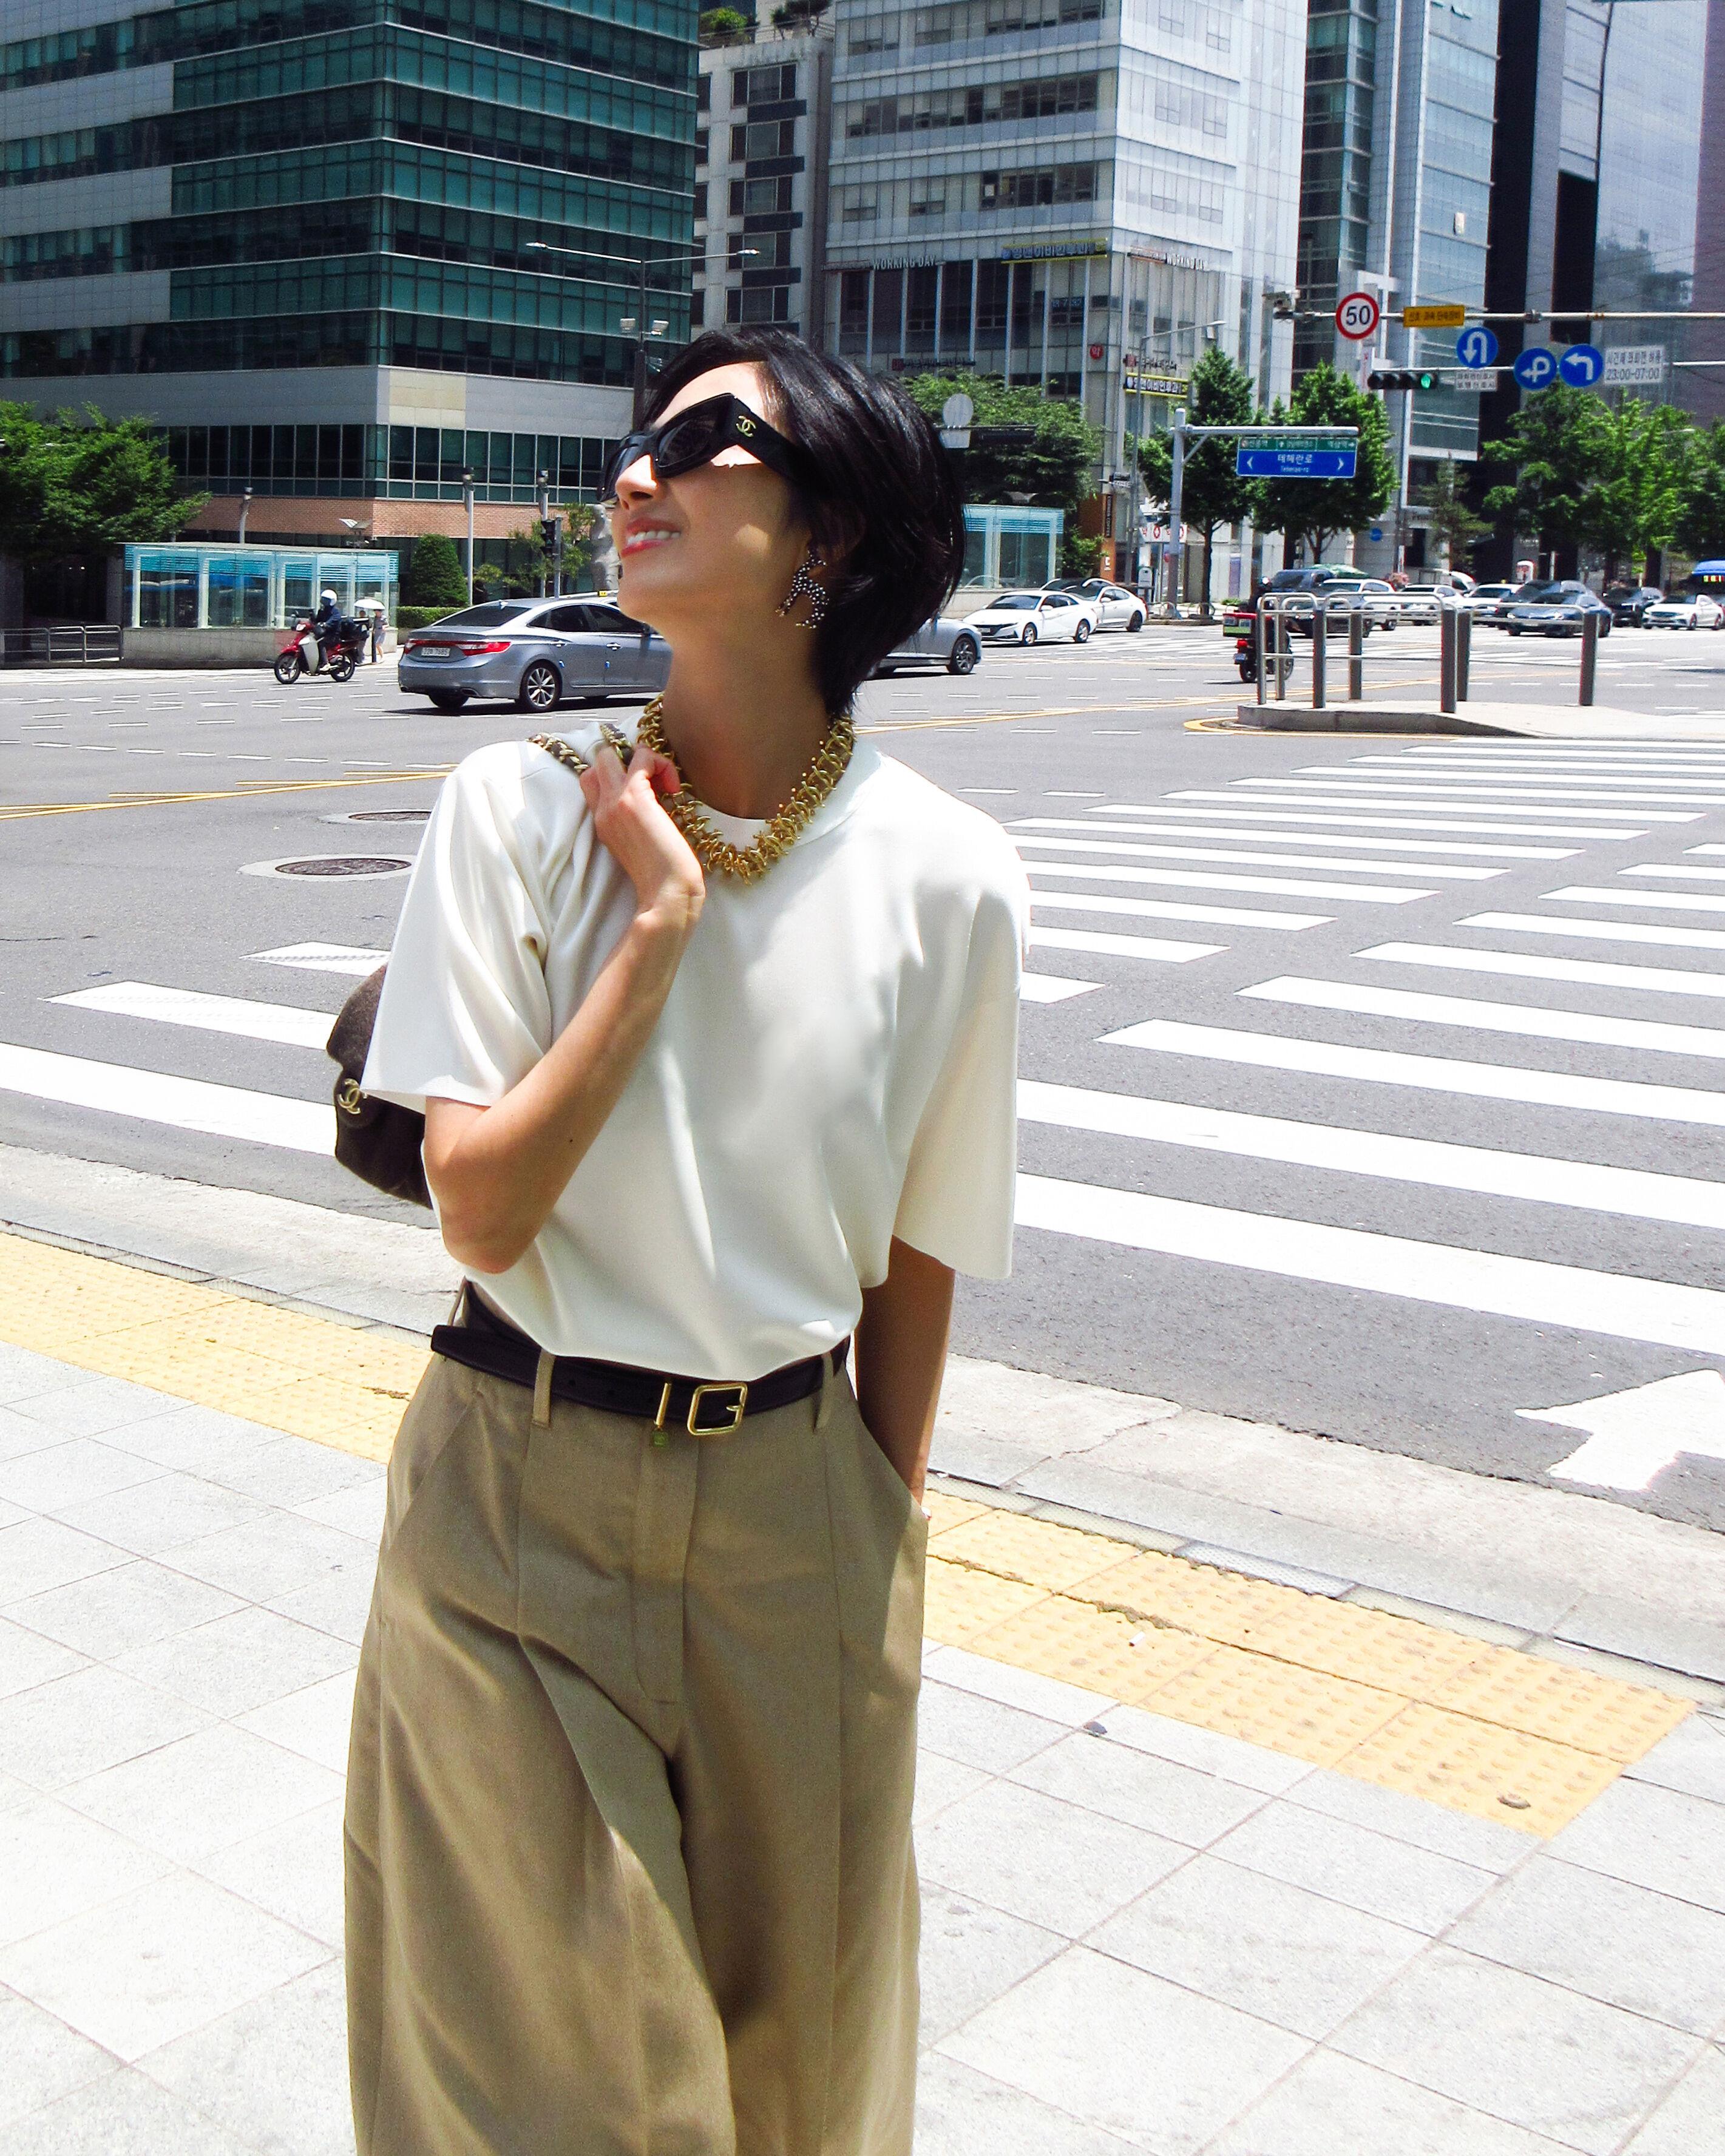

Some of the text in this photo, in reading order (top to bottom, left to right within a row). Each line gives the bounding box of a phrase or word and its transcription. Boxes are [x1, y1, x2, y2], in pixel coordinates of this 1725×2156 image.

[873, 257, 916, 270] WORKING
[918, 254, 937, 266] DAY
[1346, 305, 1371, 326] 50
[1607, 367, 1661, 381] 23:00-07:00
[1277, 454, 1313, 465] 테헤란로
